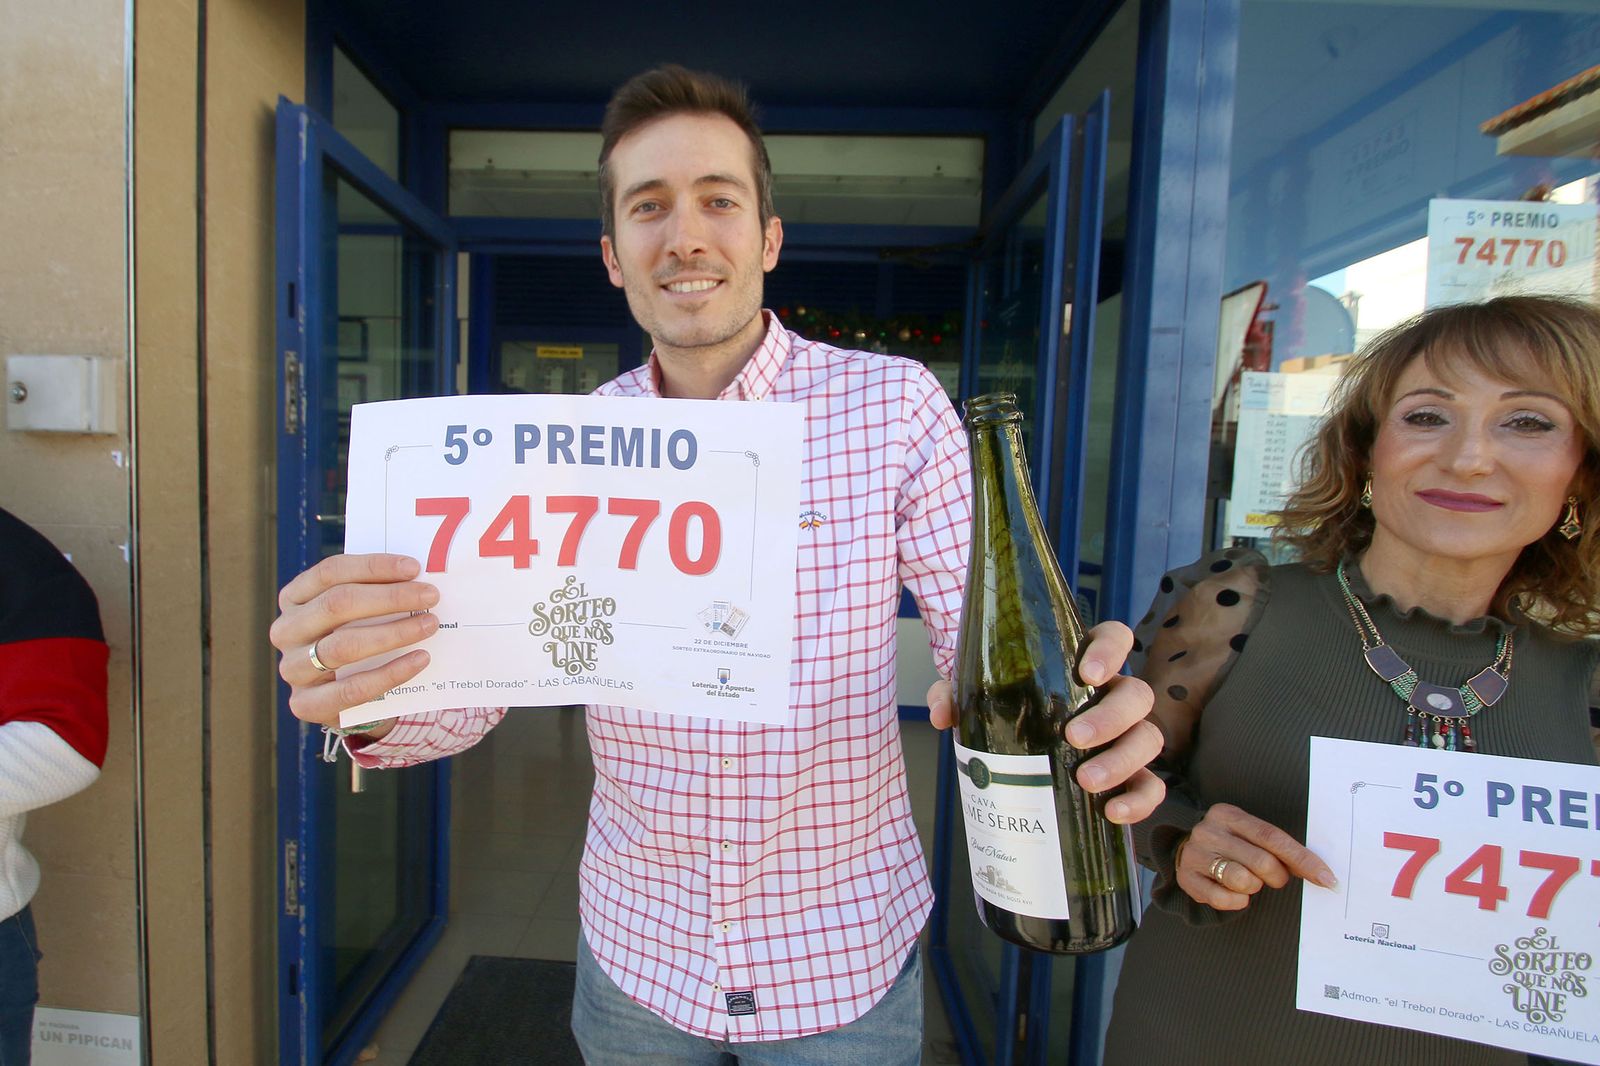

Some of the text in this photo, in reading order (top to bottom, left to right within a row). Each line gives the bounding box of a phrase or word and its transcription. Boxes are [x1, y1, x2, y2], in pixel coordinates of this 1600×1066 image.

[1490, 211, 1560, 229] PREMIO
[1454, 237, 1568, 268] 74770
[443, 423, 698, 471] 5º PREMIO
[415, 495, 723, 577] 74770
[549, 575, 588, 603] EL
[528, 597, 616, 636] SORTEO
[551, 619, 614, 645] QUE NOS
[713, 640, 749, 649] DICIEMBRE
[543, 641, 598, 676] UNE
[386, 685, 429, 697] Admon.
[449, 680, 483, 690] Trebol
[538, 677, 560, 688] LAS
[562, 675, 634, 690] CABAÑUELAS
[706, 689, 740, 699] del Estado
[725, 684, 755, 693] Apuestas
[970, 794, 997, 810] CAVA
[1413, 772, 1600, 831] 5º PRE
[987, 812, 1046, 834] SERRA
[984, 845, 1017, 863] Nature
[1383, 831, 1600, 928] 747
[1377, 939, 1416, 951] Nacional
[1514, 926, 1560, 950] EL
[1488, 943, 1592, 976] SORTEO
[1513, 970, 1588, 998] QUE NOS
[1340, 989, 1381, 1004] Admon.
[1401, 999, 1436, 1014] Trebol
[1495, 1018, 1520, 1030] LAS
[1523, 1022, 1600, 1044] CABAÑUELA
[1502, 983, 1567, 1024] UNE
[67, 1033, 133, 1051] PIPICAN
